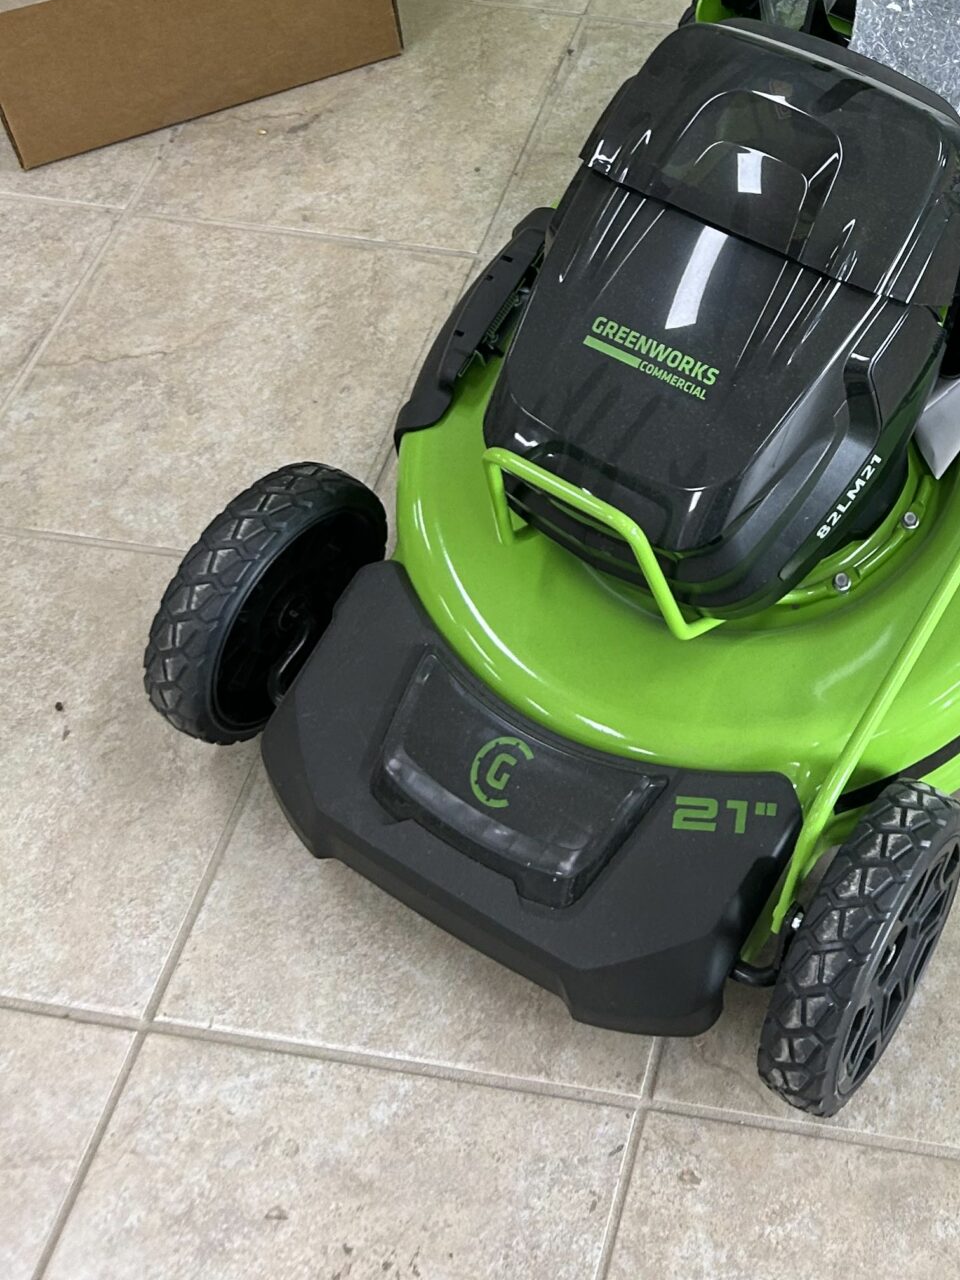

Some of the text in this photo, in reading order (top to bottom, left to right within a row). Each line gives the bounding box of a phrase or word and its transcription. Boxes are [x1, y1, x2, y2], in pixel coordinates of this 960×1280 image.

[591, 316, 720, 386] GREENWORKS
[639, 361, 706, 401] COMMERCIAL
[816, 454, 882, 539] 82LM21
[672, 795, 778, 834] 21"
